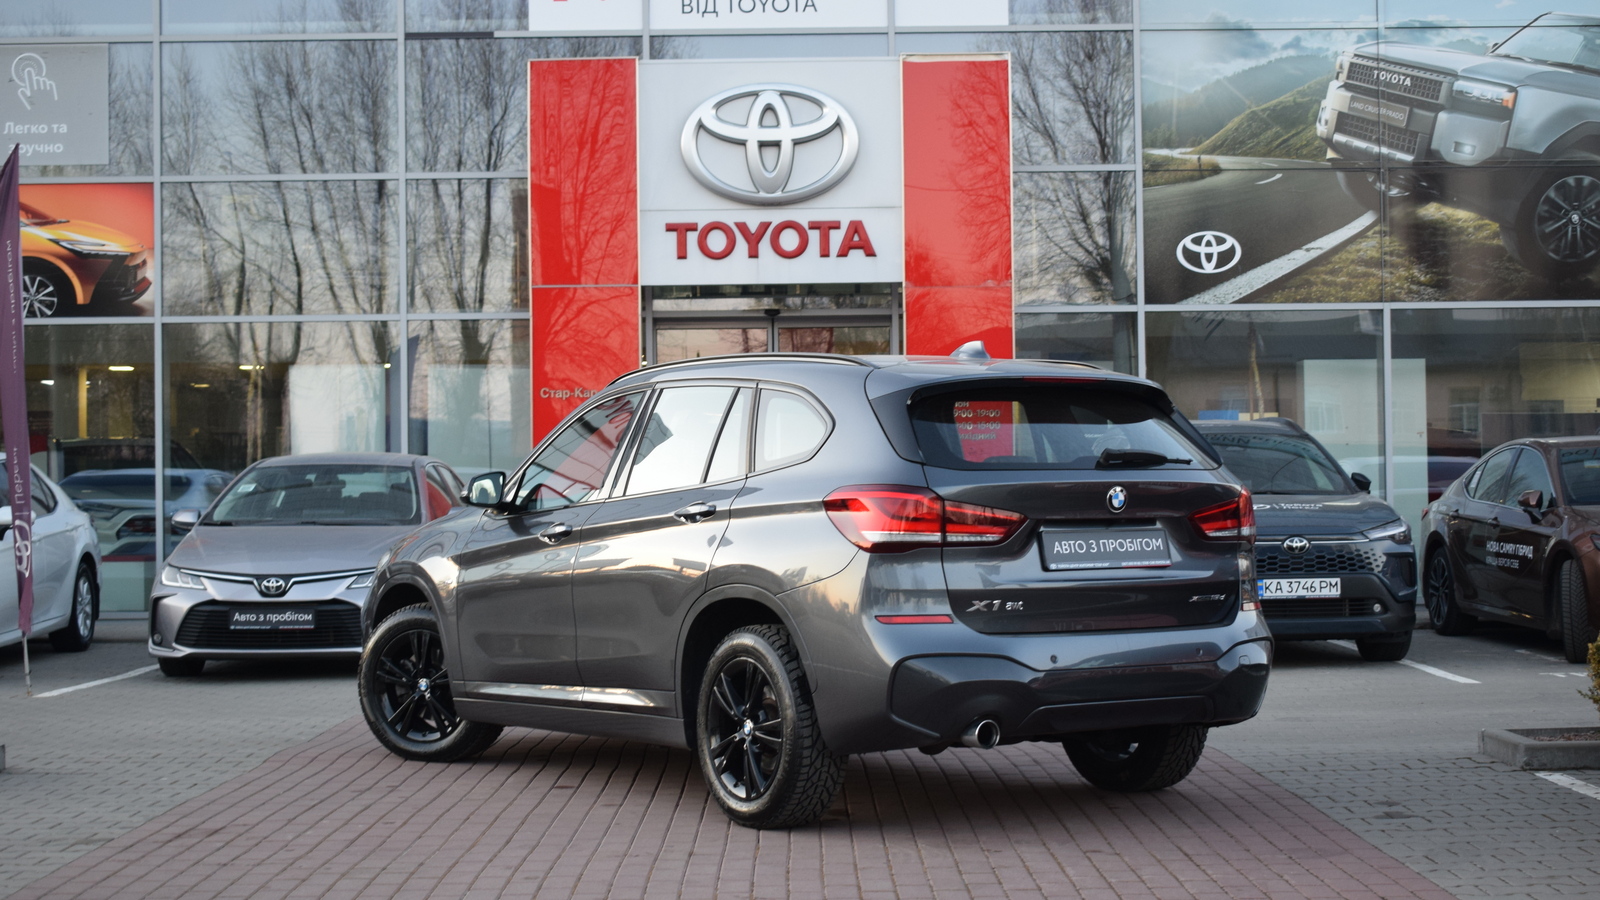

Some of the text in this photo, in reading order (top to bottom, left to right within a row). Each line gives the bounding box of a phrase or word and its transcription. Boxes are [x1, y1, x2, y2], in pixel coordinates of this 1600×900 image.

[681, 0, 719, 18] ВІД
[1373, 70, 1411, 86] TOYOTA
[1350, 101, 1365, 111] LAND
[3, 121, 68, 134] Легко та
[665, 219, 877, 260] TOYOTA
[1053, 540, 1087, 554] АВТО
[1099, 538, 1164, 553] ПРОБІГОМ
[1264, 580, 1339, 594] KA 3746 PM
[965, 599, 1002, 612] X1
[233, 611, 313, 624] Авто з пробігом
